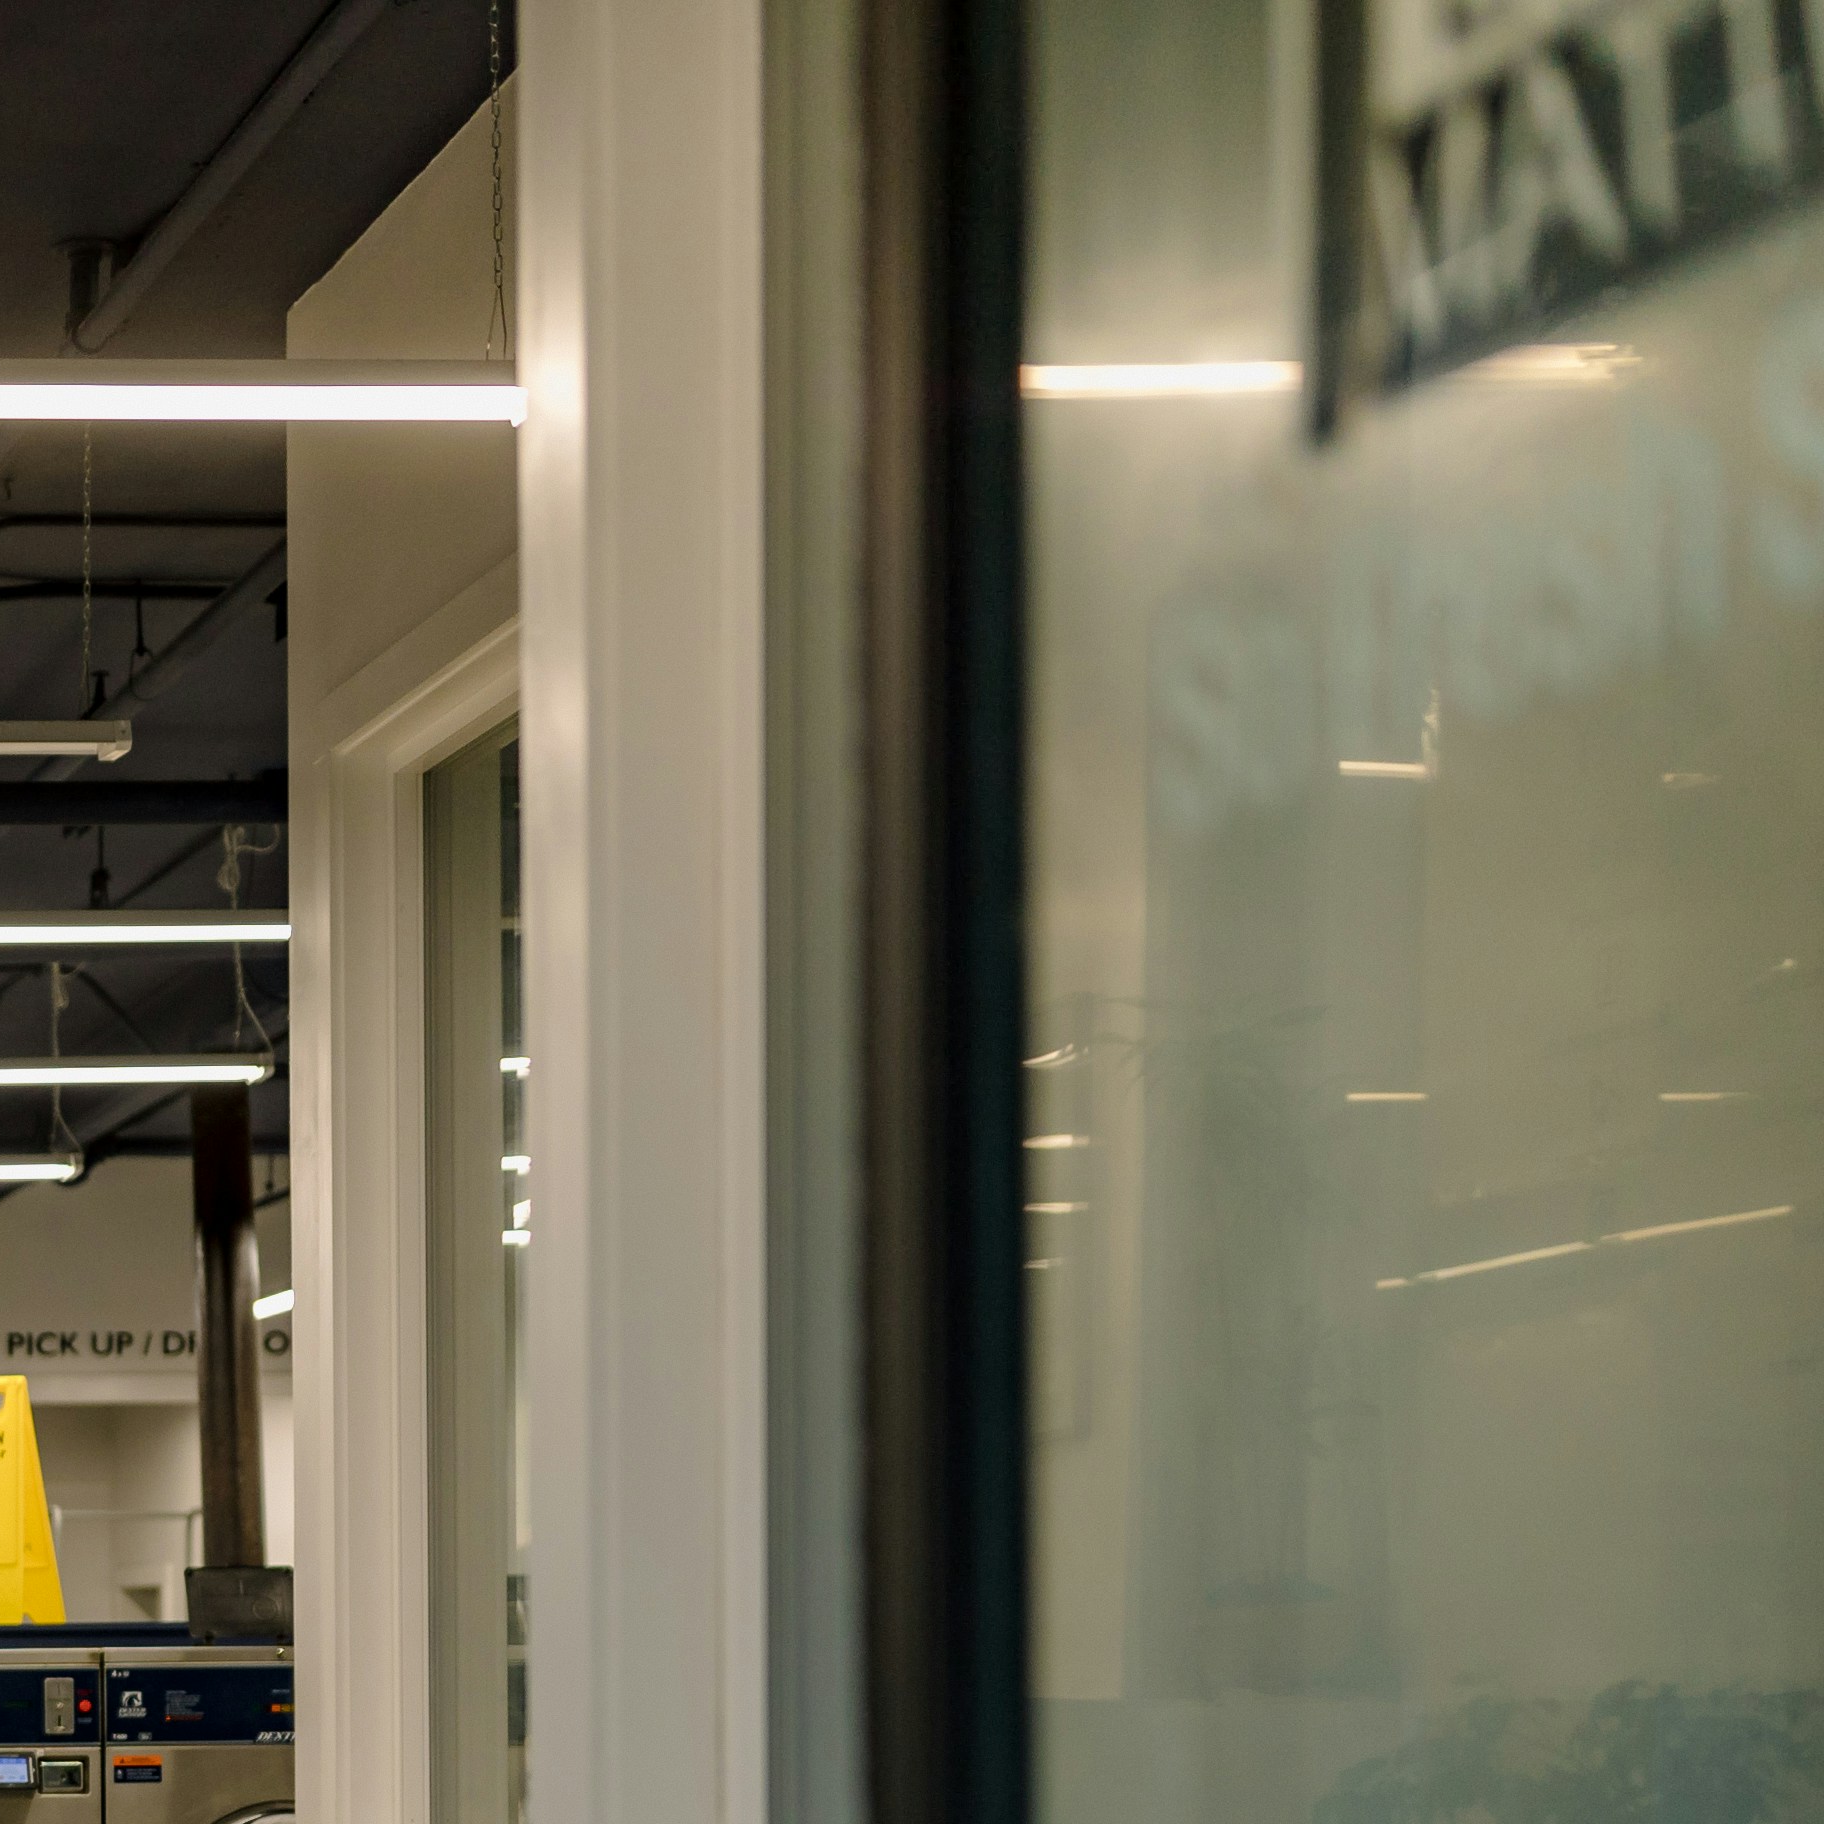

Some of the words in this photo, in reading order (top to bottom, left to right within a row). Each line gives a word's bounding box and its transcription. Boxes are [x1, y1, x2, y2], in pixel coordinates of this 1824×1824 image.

[7, 1331, 78, 1356] PICK
[91, 1331, 134, 1356] UP
[143, 1333, 153, 1356] /
[255, 1731, 295, 1742] DEXT
